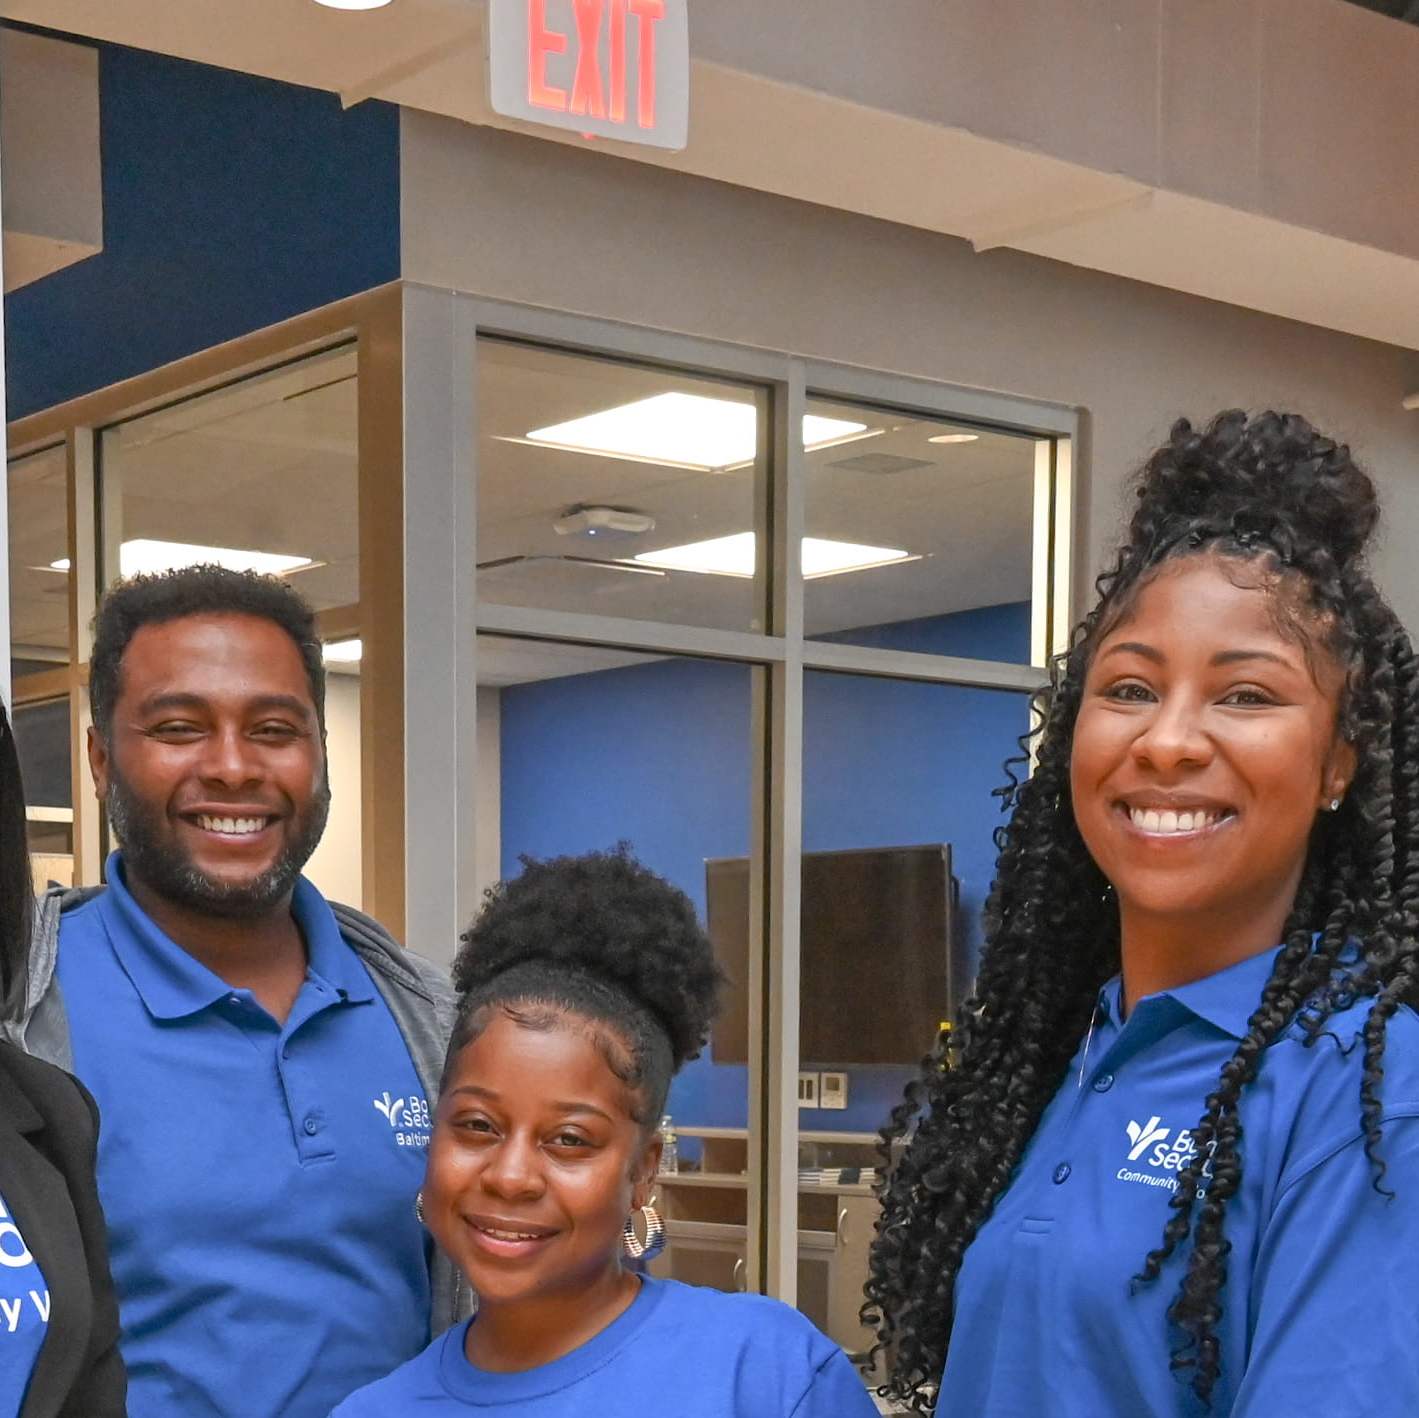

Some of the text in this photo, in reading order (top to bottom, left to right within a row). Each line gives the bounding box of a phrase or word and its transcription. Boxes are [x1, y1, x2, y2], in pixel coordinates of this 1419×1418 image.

[528, 0, 666, 129] EXIT
[402, 1109, 434, 1128] Sec
[1116, 1167, 1181, 1194] Community
